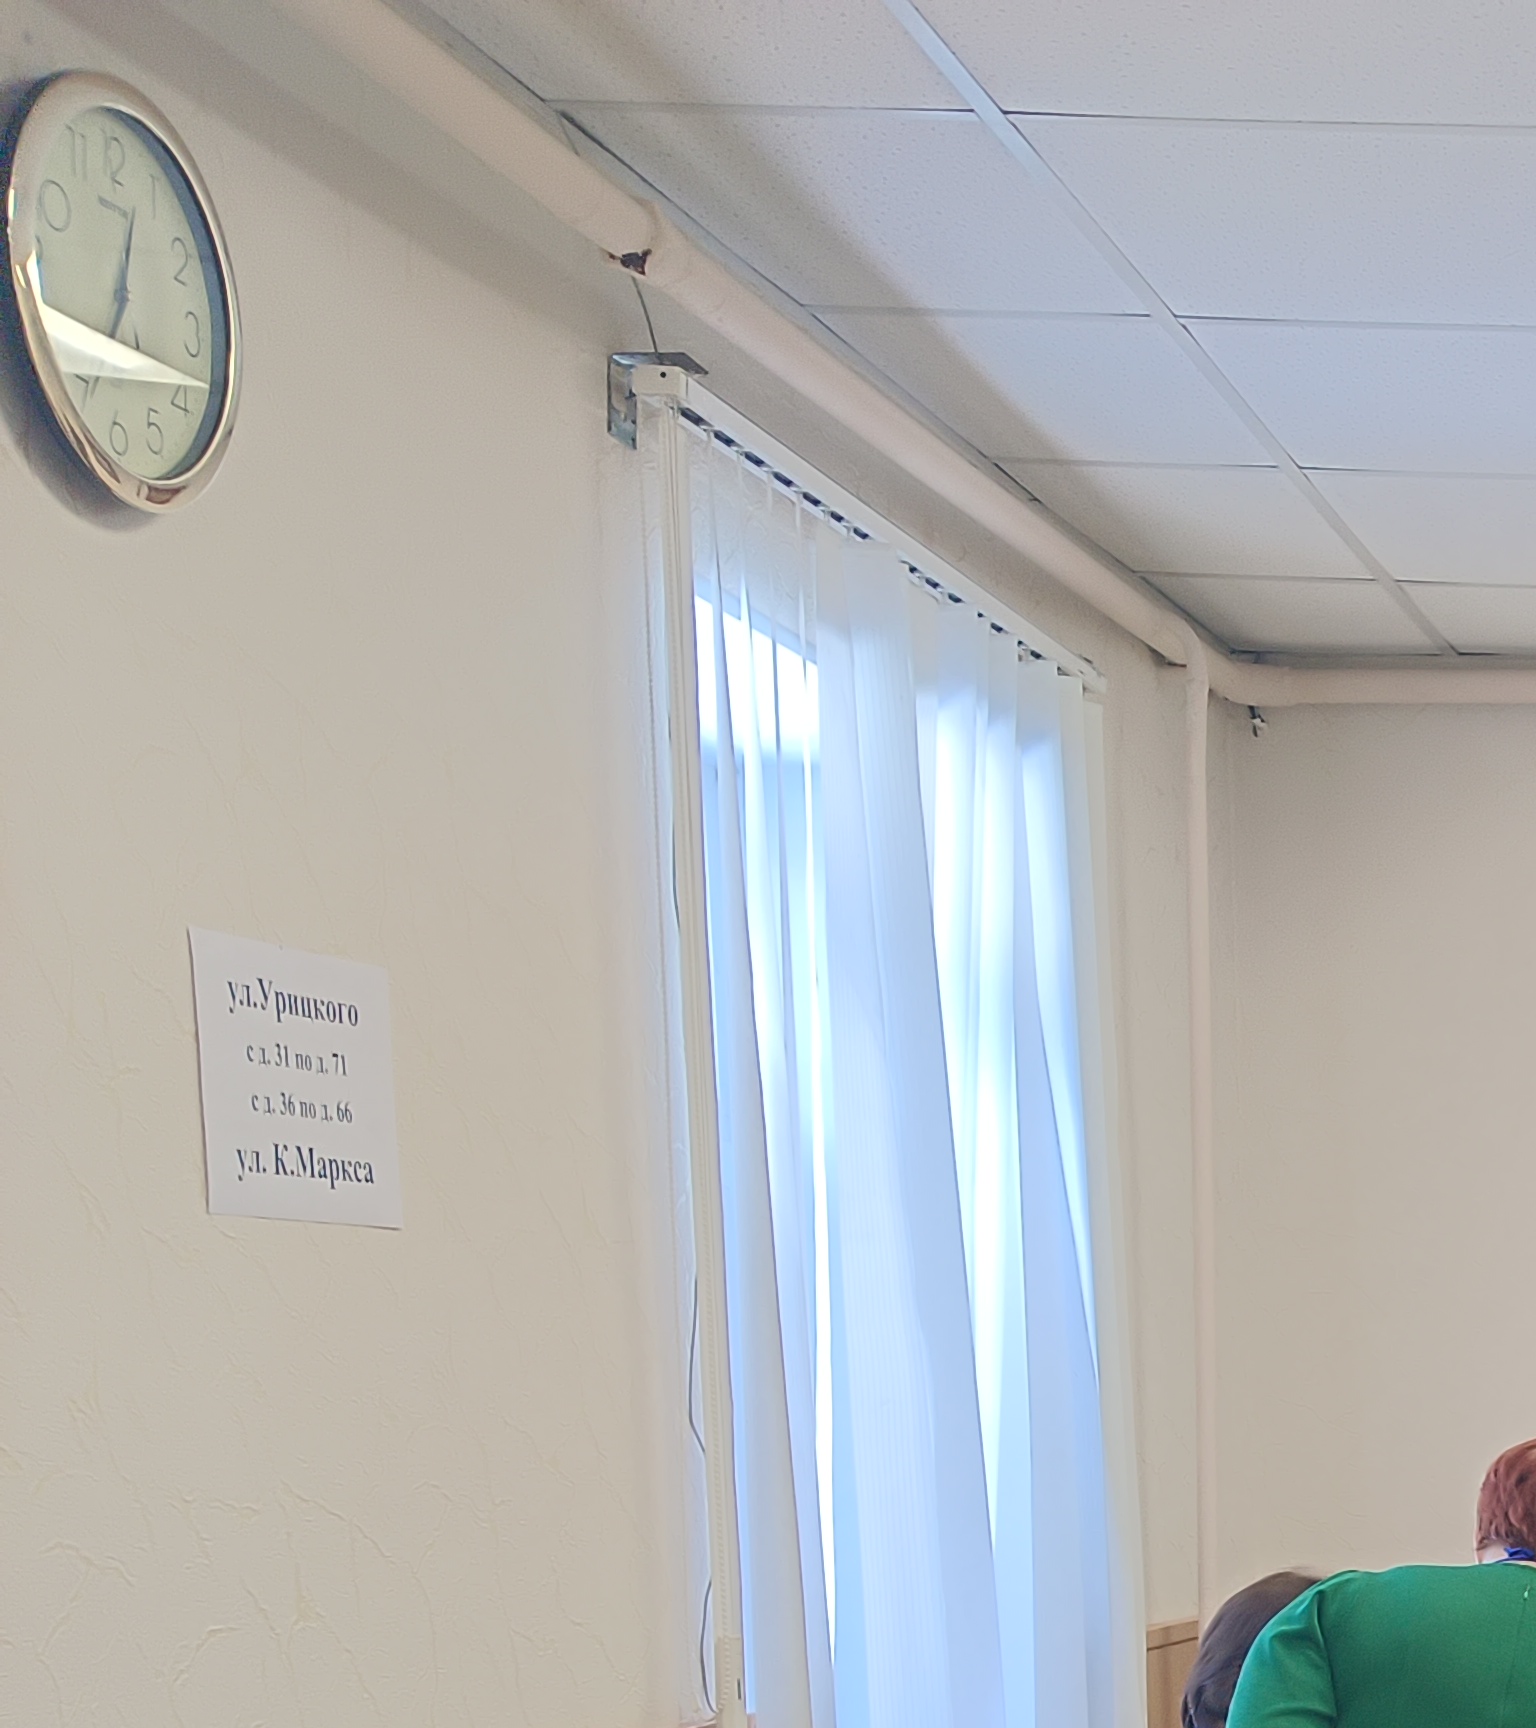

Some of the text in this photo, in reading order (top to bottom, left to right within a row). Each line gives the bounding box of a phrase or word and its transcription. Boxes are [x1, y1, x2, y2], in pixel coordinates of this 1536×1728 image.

[171, 237, 188, 286] 2
[184, 311, 201, 358] 3
[109, 409, 128, 456] 6
[146, 407, 164, 456] 5
[246, 1043, 348, 1076] с д. 31 по д. 71
[251, 1092, 353, 1124] с д. 36 по д. 66
[236, 1142, 375, 1190] ул. К.Маркса
